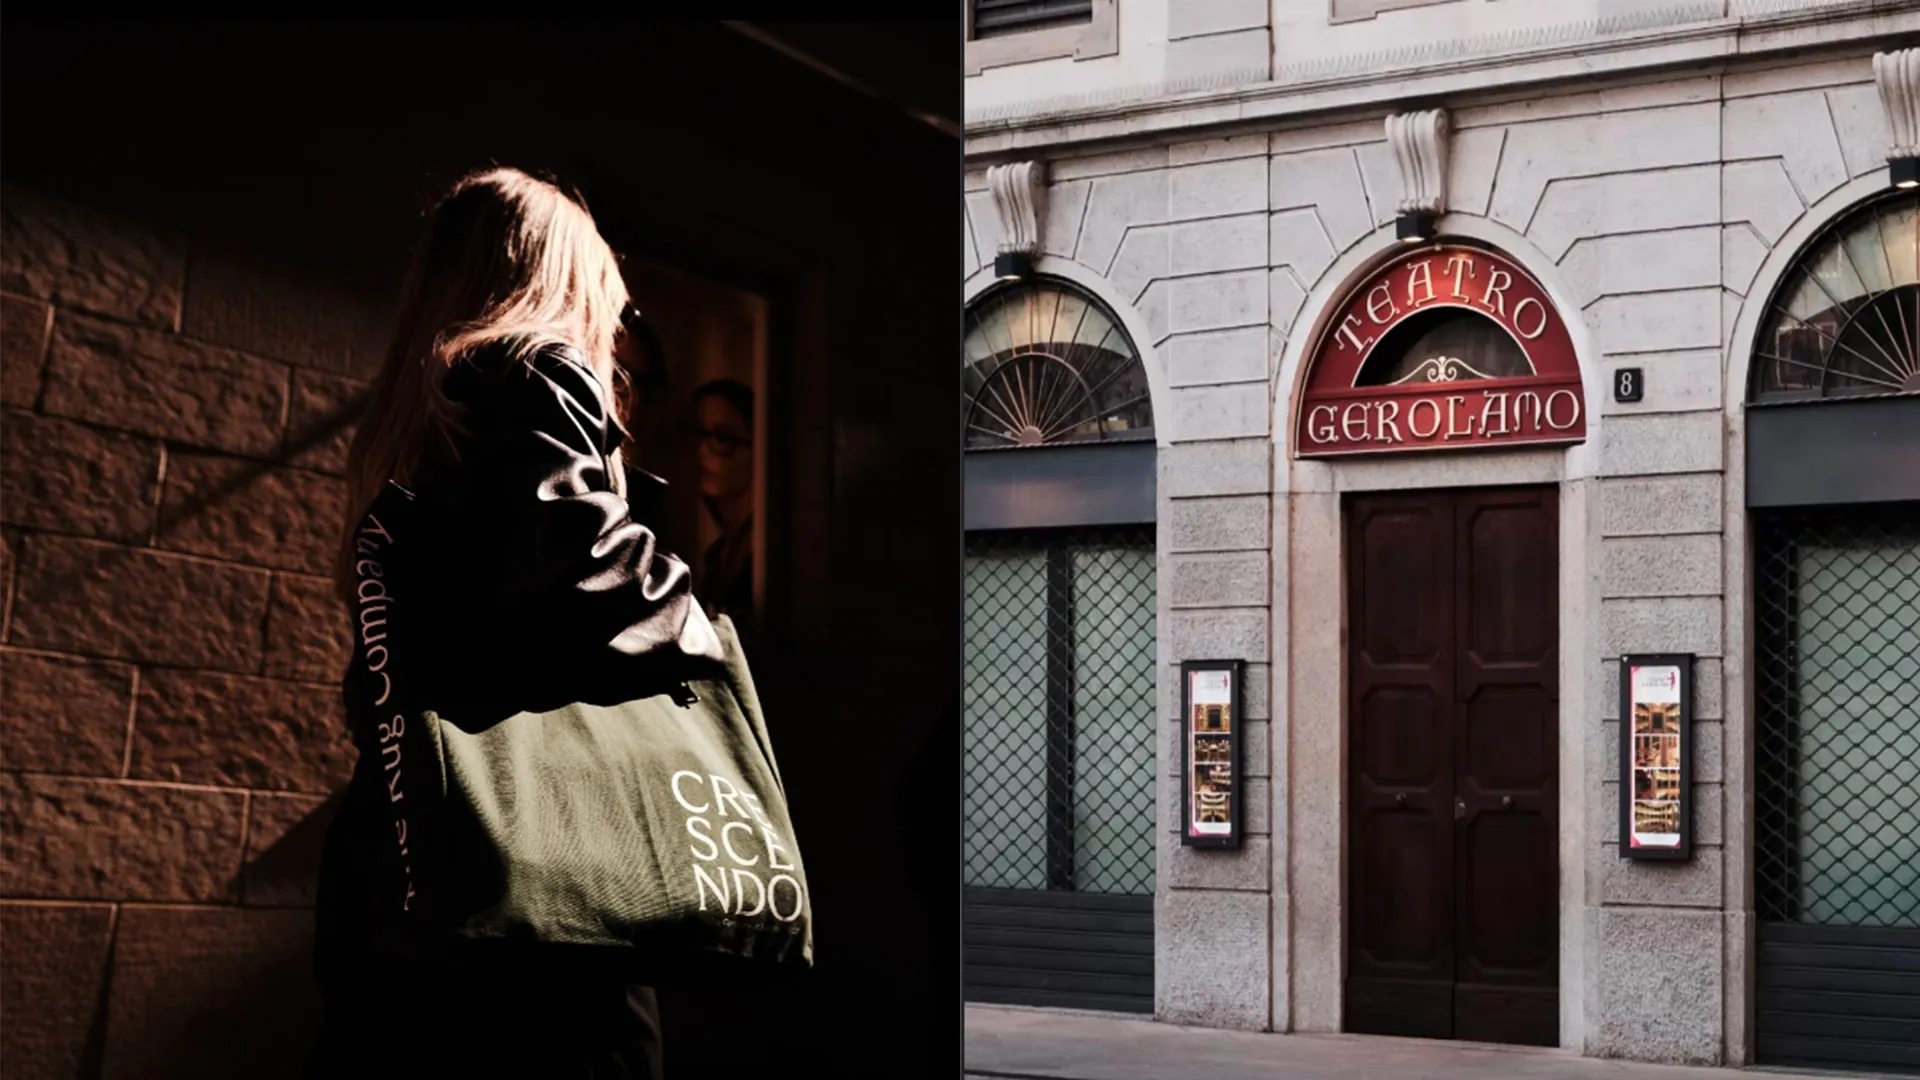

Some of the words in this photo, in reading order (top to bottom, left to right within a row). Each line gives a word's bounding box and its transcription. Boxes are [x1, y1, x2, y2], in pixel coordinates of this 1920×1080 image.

[1333, 256, 1548, 354] TEATRO
[1620, 371, 1633, 397] 8
[1307, 389, 1580, 445] GEROLAMO
[685, 816, 796, 872] SCE
[691, 863, 804, 923] NDO
